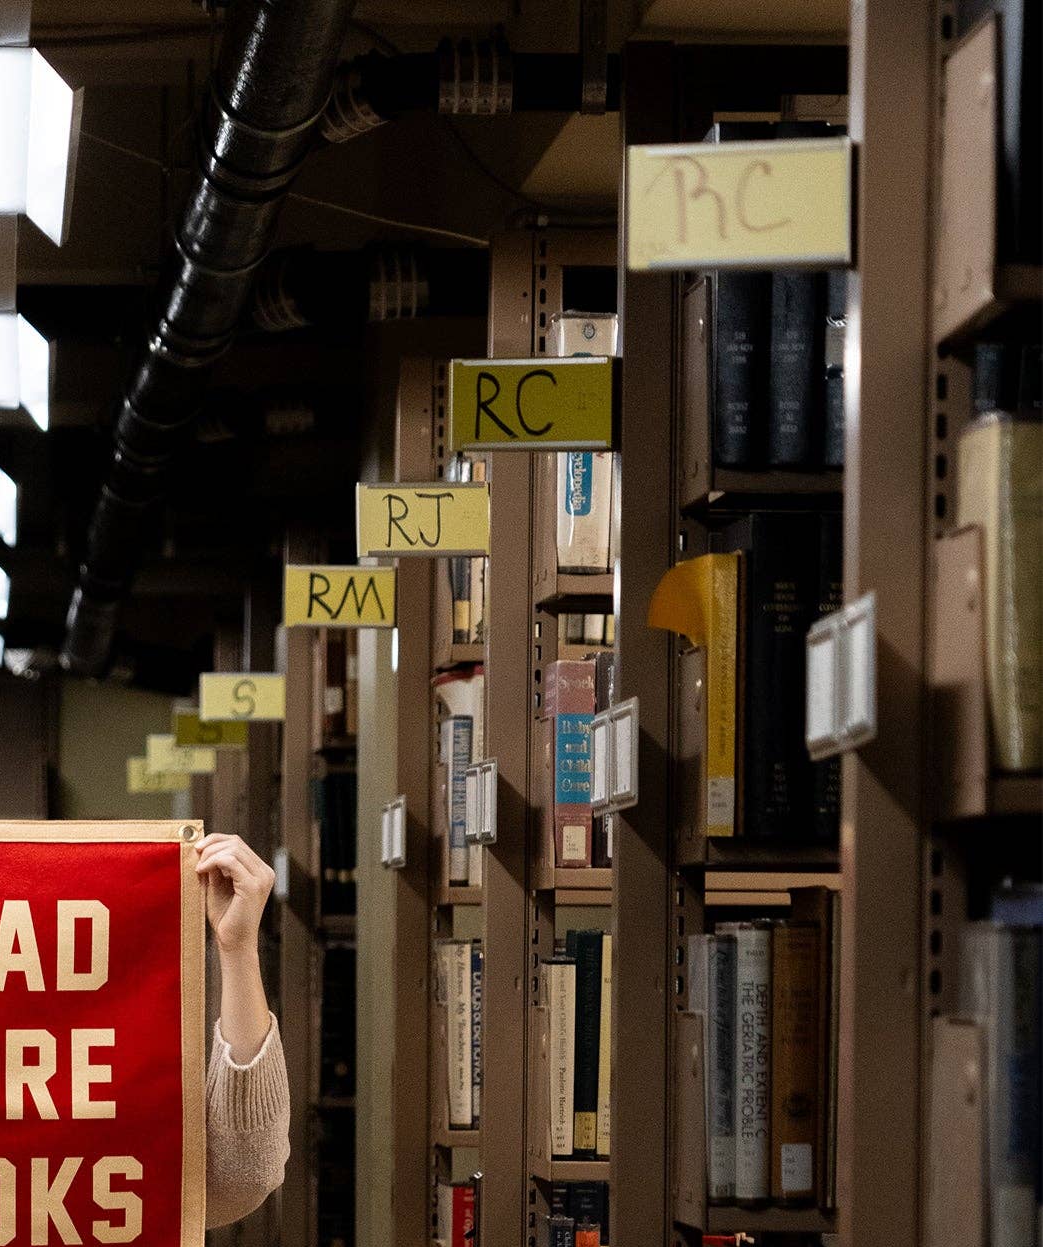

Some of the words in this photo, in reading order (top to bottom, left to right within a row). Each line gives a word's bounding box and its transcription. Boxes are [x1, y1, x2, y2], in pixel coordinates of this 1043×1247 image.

[648, 155, 794, 244] RC
[474, 369, 558, 440] RC
[382, 492, 454, 548] RJ
[307, 572, 385, 620] RM
[231, 679, 257, 717] S
[742, 981, 755, 1005] THE
[756, 983, 768, 1026] DEPTH
[742, 1012, 755, 1084] GERIATRIC
[756, 1033, 768, 1065] AND
[741, 1089, 754, 1141] PROBLE
[756, 1071, 768, 1121] EXTENT
